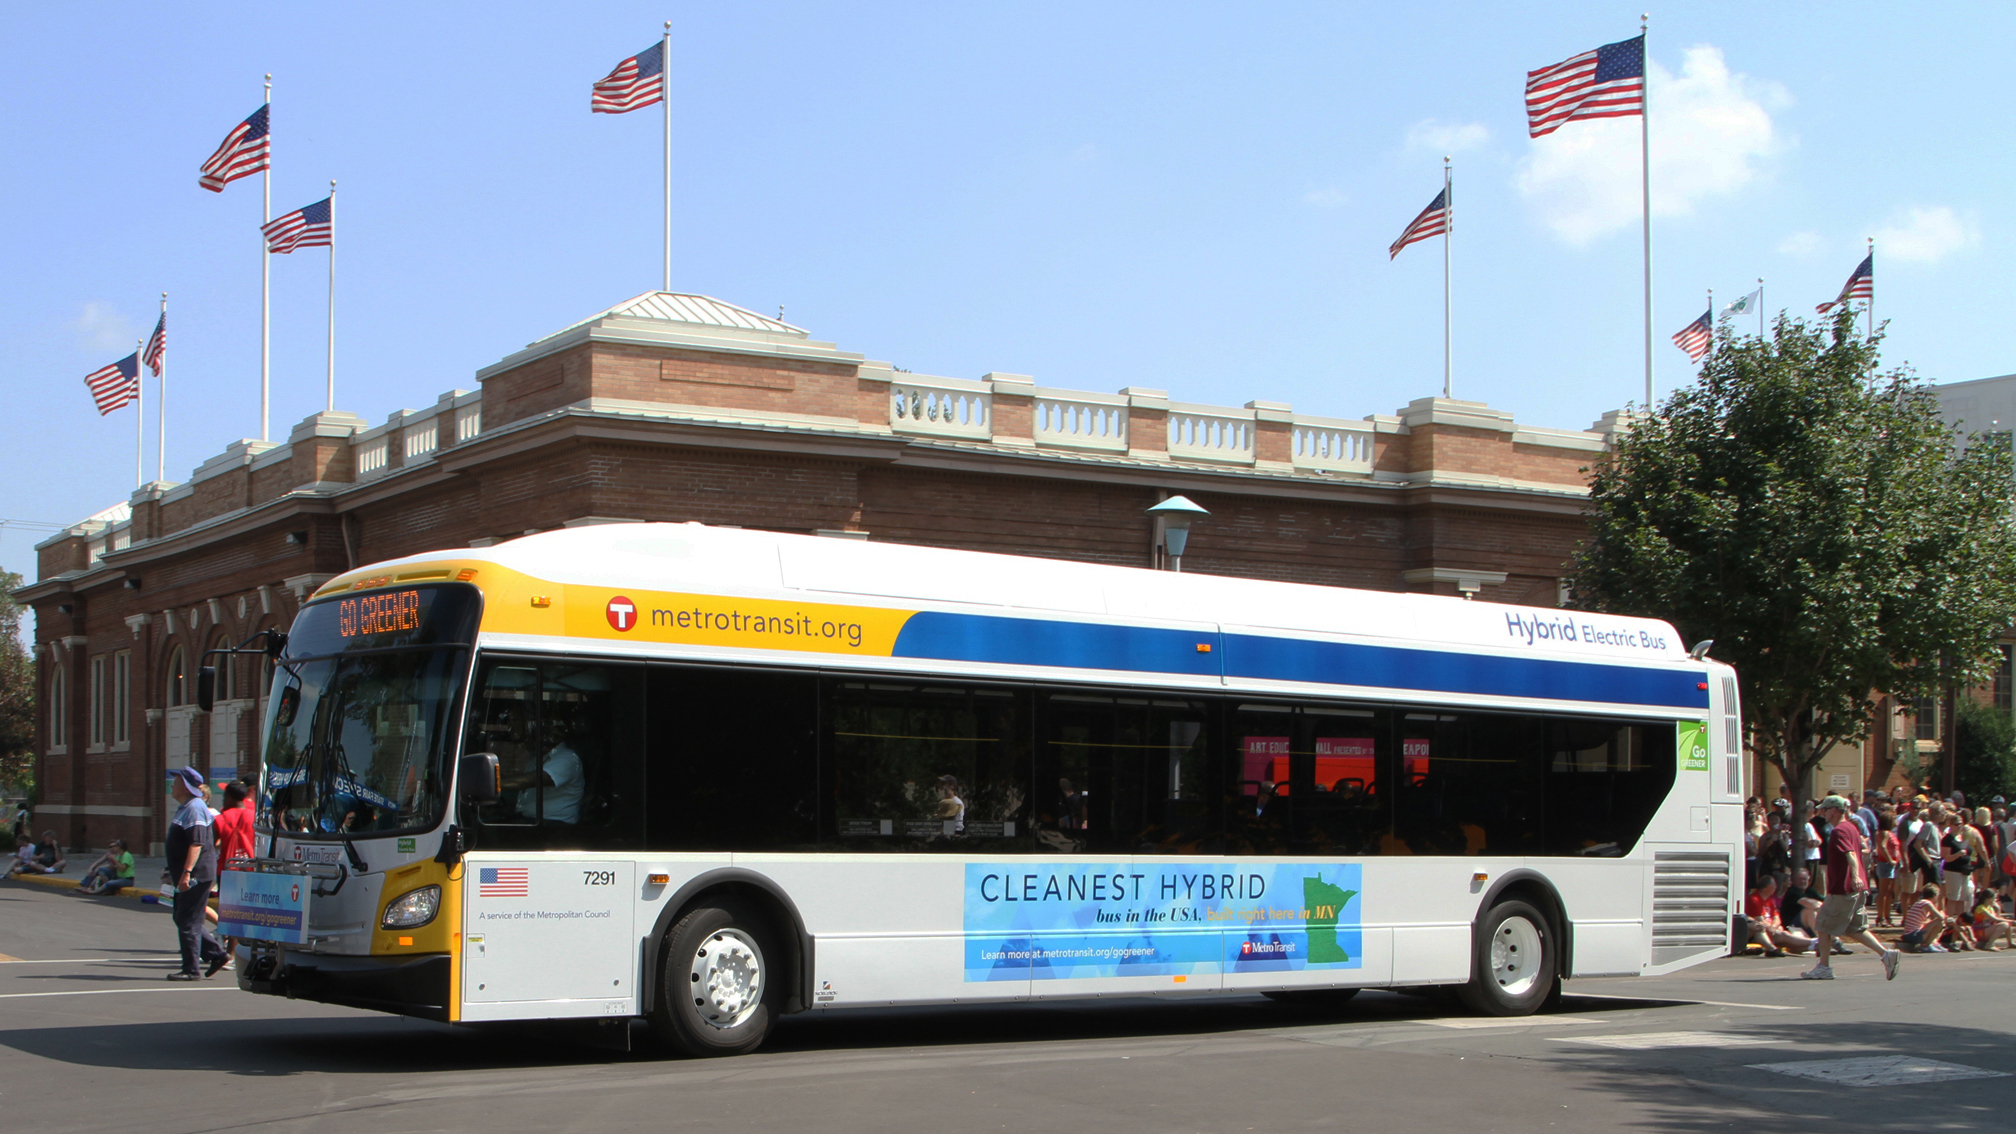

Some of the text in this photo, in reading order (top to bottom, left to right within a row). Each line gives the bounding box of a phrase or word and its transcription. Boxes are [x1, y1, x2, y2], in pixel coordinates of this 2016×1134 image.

[340, 590, 419, 637] GO GREENER
[651, 607, 862, 647] metrotransit.org
[1505, 611, 1667, 650] Hybrid Electric Bus
[1249, 742, 1266, 754] ART
[1692, 745, 1706, 758] Go
[1680, 759, 1706, 768] GREENER
[583, 871, 616, 886] 7291
[240, 888, 280, 905] Learn more
[980, 874, 1265, 902] CLEANEST HYBRID
[221, 909, 297, 927] metrotransit.org/gogreener
[479, 910, 611, 921] A service of the Metropolitan Council
[1096, 905, 1337, 924] bus in the USA, built right here in MN
[981, 946, 1155, 960] Learn more at metrotransit.org/gogreener
